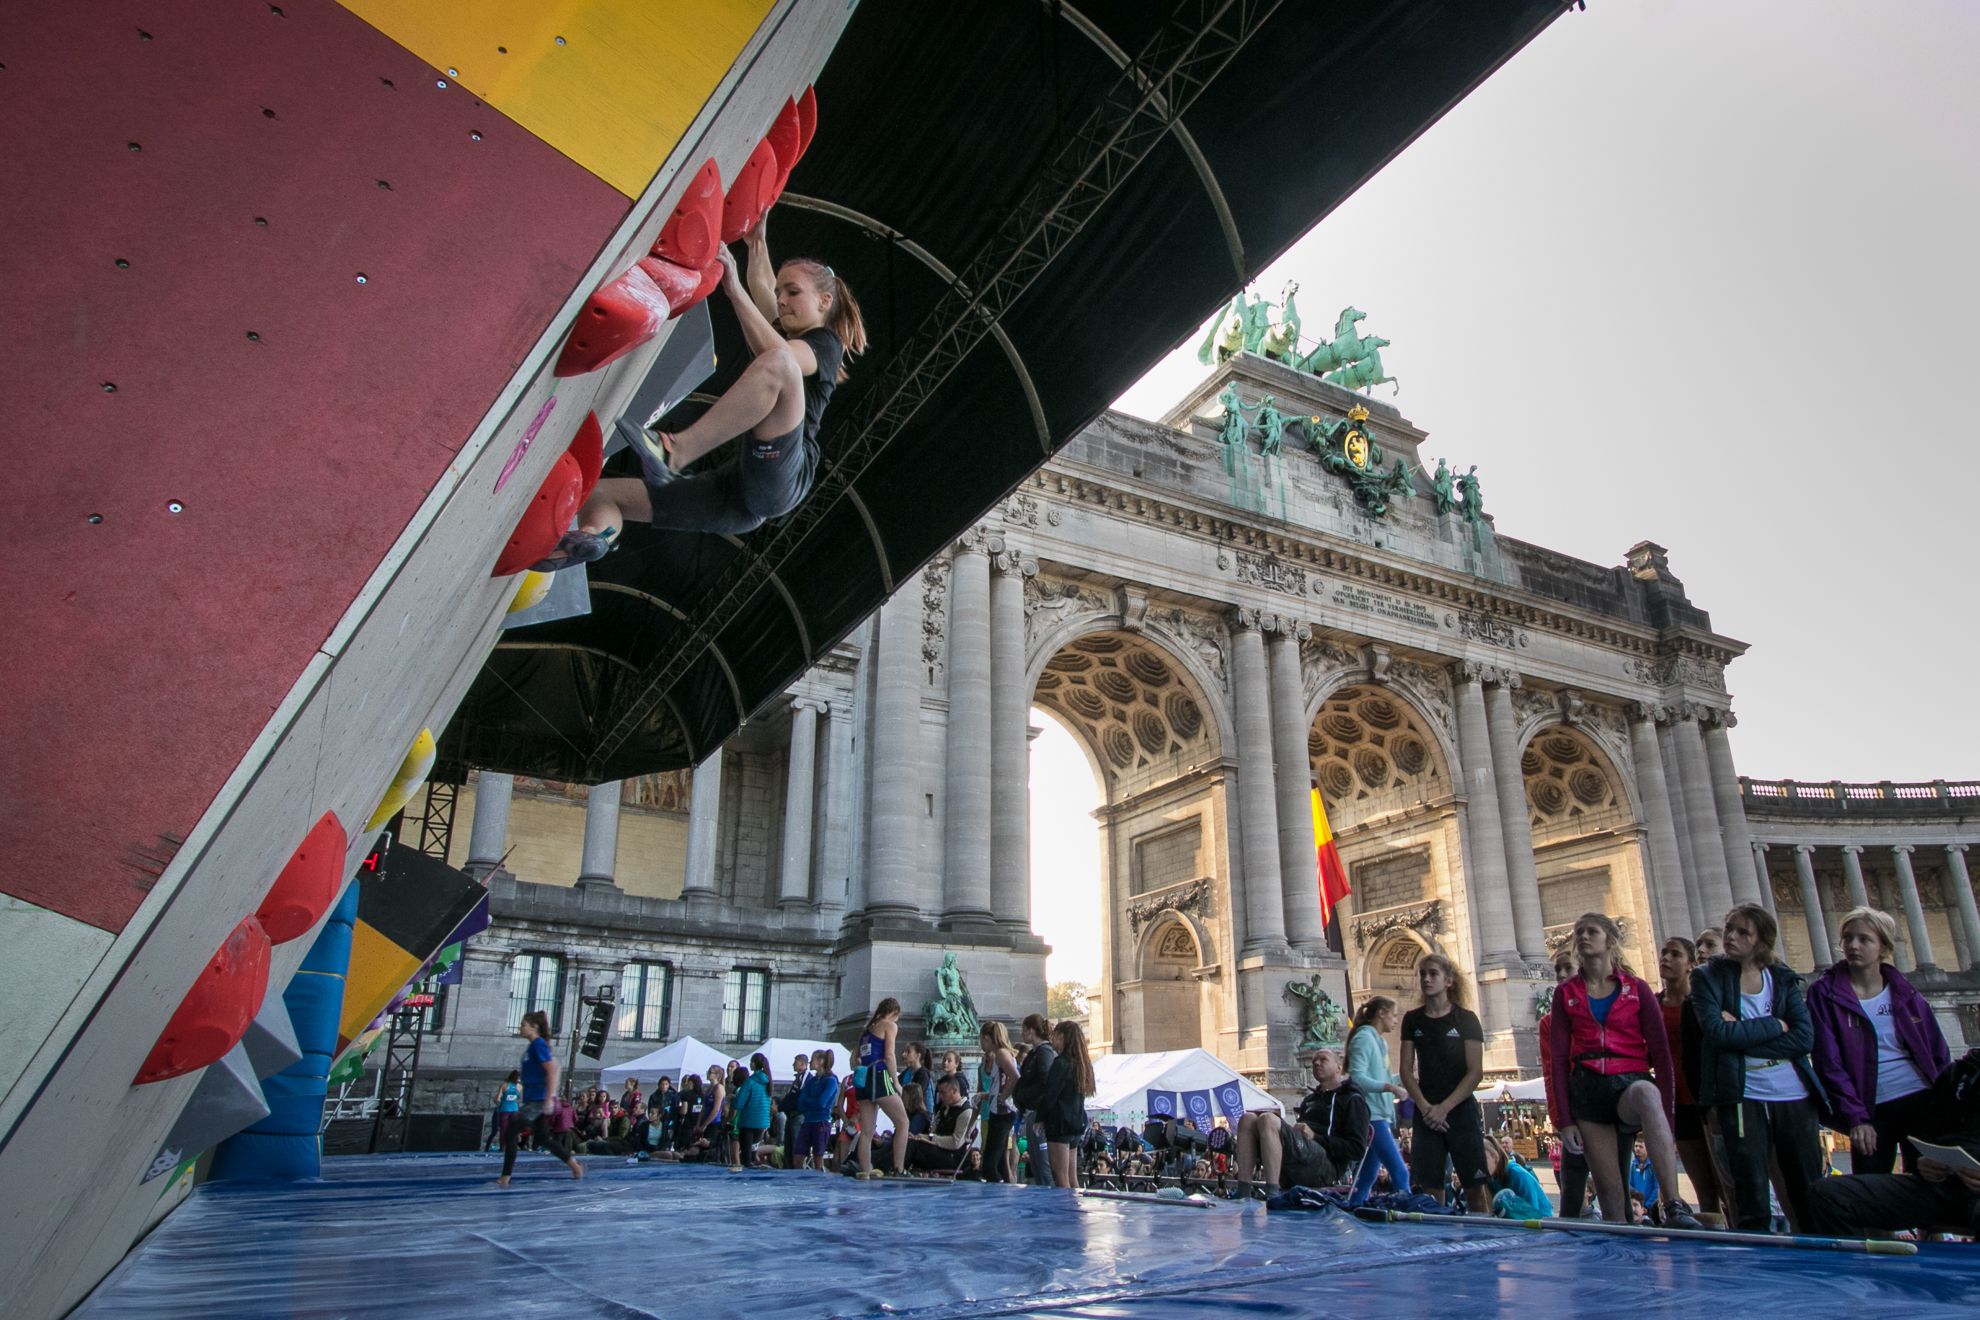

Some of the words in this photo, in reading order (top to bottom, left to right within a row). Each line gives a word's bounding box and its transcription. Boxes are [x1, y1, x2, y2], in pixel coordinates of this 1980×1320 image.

[1332, 595, 1345, 605] VAN
[1335, 590, 1370, 604] OPGERICHT
[1342, 585, 1353, 593] DIT
[1357, 588, 1392, 602] MONUMENT
